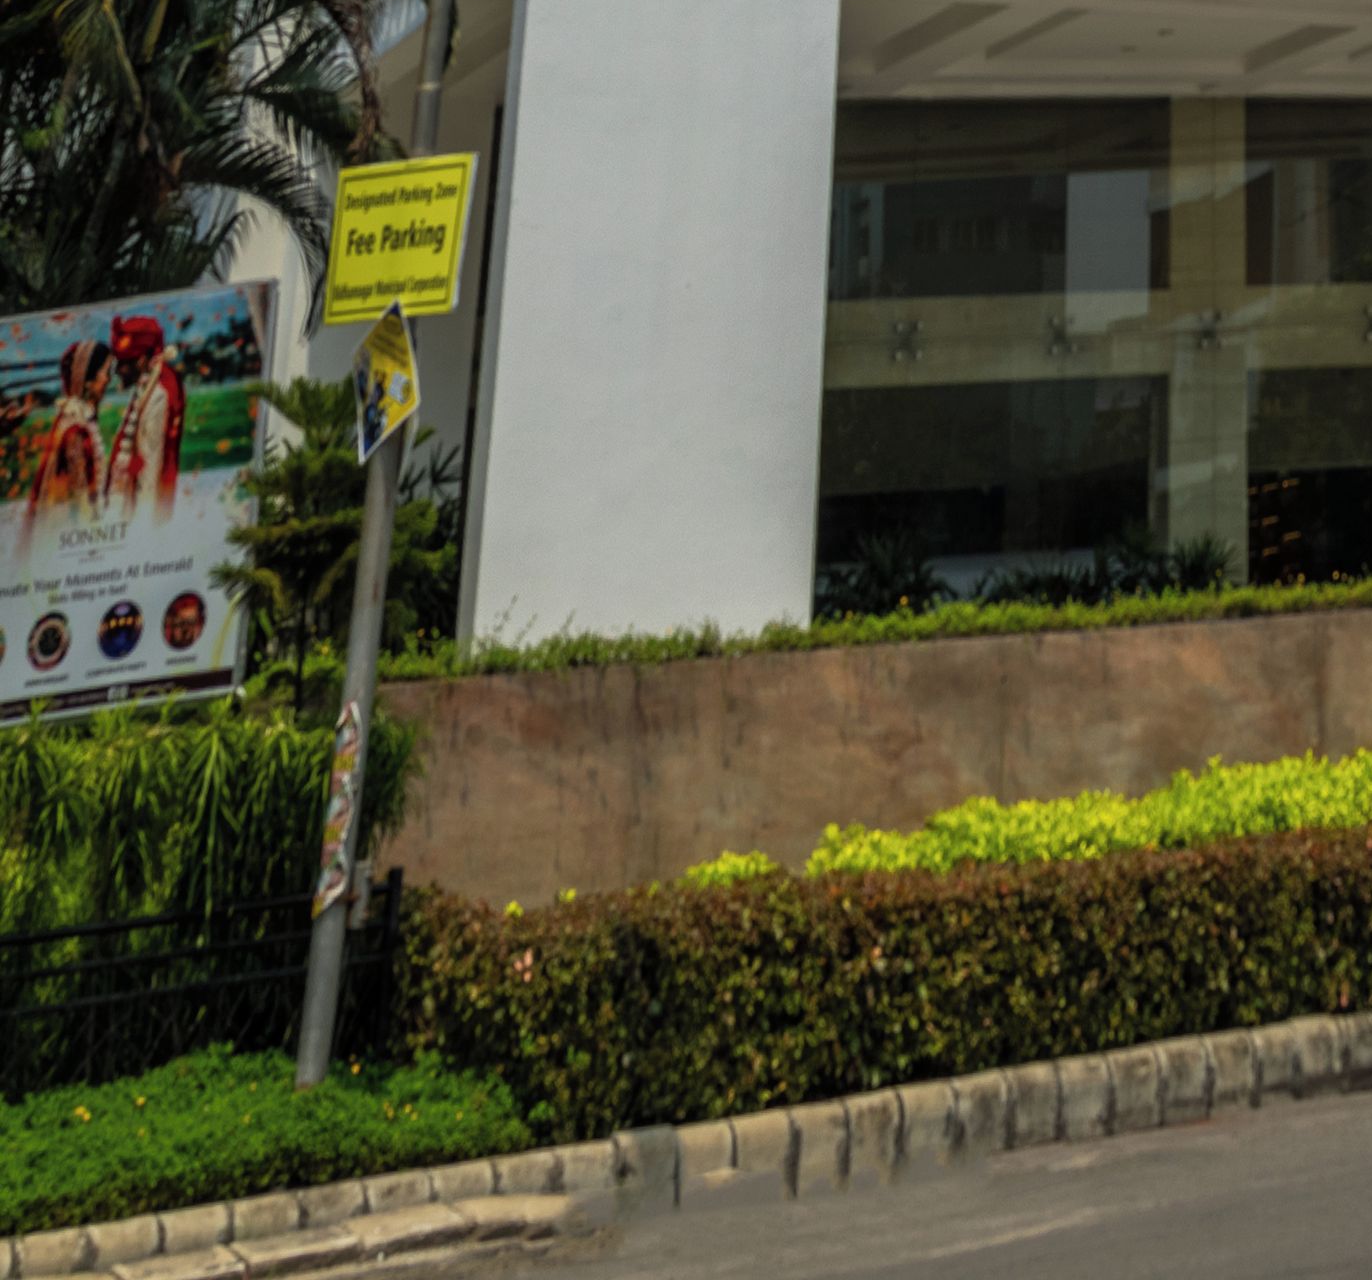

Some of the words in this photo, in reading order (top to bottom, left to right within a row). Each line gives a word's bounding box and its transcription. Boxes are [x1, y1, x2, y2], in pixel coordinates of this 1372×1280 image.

[345, 189, 396, 213] Designated
[399, 184, 433, 206] Parking
[435, 181, 457, 201] Zone
[346, 228, 376, 256] Fee
[380, 218, 447, 254] Parking
[59, 521, 129, 549] SONNET
[64, 568, 122, 588] Moments
[143, 555, 194, 575] Emerald
